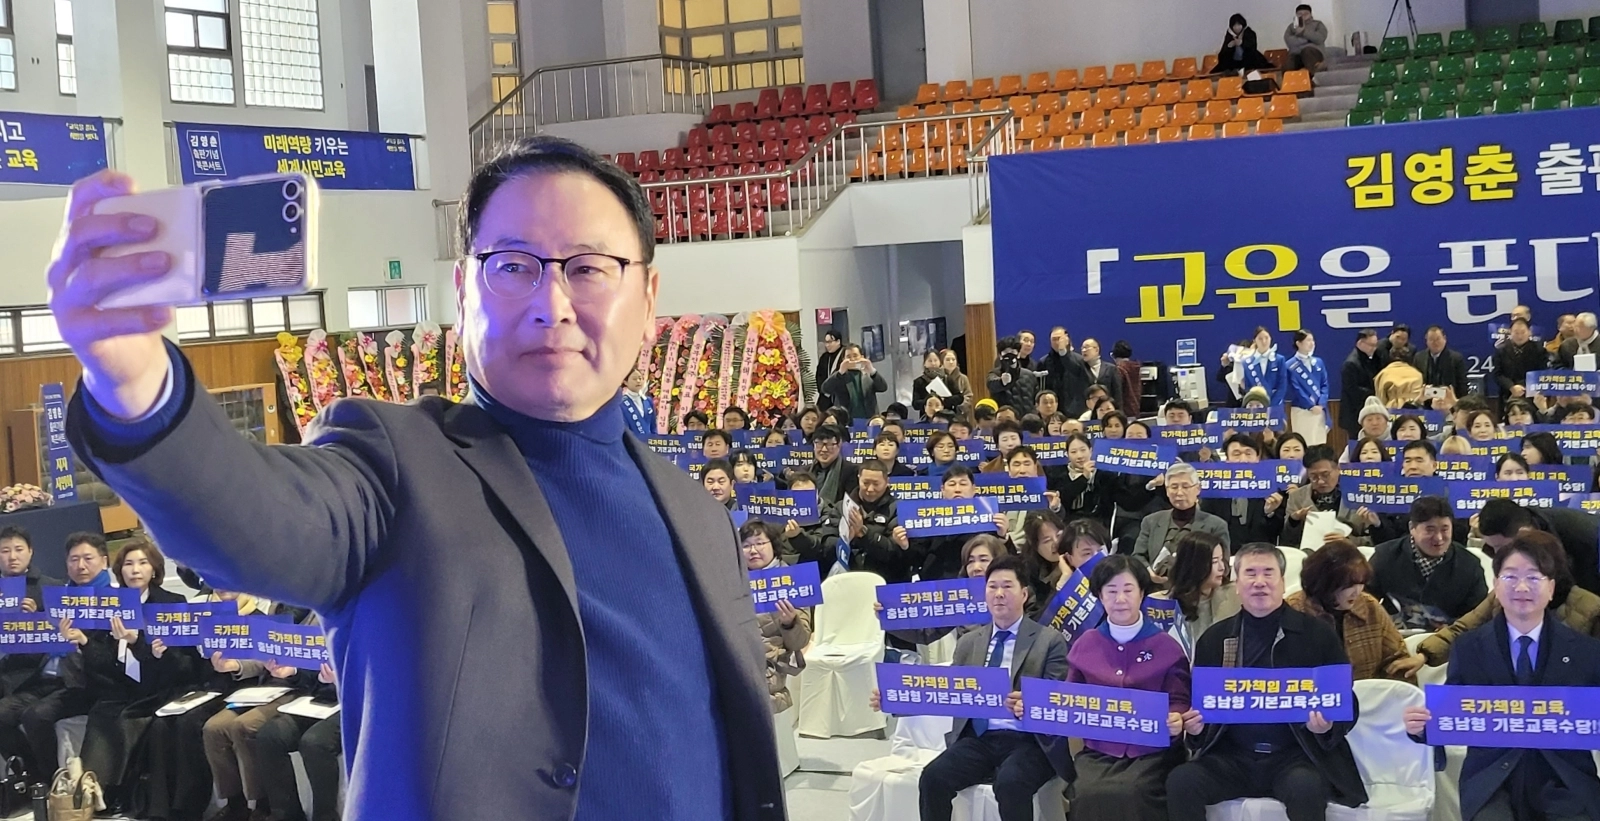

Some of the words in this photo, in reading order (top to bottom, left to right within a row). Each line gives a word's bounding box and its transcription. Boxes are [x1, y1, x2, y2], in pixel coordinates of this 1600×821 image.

[263, 134, 312, 154] 미래역량
[314, 136, 349, 155] 키우는
[5, 149, 38, 171] 교육
[277, 158, 346, 178] 세계시민교육
[1346, 145, 1518, 208] 김영춘
[1535, 142, 1600, 196] 출
[1087, 244, 1401, 331] 「교육을
[1552, 431, 1580, 439] 가책임
[1563, 440, 1600, 448] 기본교육
[1036, 451, 1068, 459] 기본교육
[1121, 459, 1169, 470] 기본교육수당!
[1213, 480, 1271, 489] 기본교육수당!
[998, 494, 1041, 503] 본교육수당!
[1376, 494, 1421, 504] 기본교육
[918, 507, 953, 517] 국가책임
[957, 505, 977, 515] 교육,
[905, 519, 932, 529] 충남형
[935, 514, 992, 526] 기본교육수당!
[749, 578, 767, 590] 책임
[771, 575, 795, 587] 교육,
[61, 596, 98, 606] 국가책임
[101, 597, 121, 607] 교육,
[900, 590, 943, 604] 국가책임
[948, 588, 973, 601] 교육,
[79, 608, 135, 620] 기본교육수당!
[156, 612, 191, 623] 국가책임
[887, 606, 919, 620] 충남형
[1050, 596, 1079, 630] 가책임
[3, 621, 34, 631] 국가책임
[173, 625, 199, 636] 기본교
[214, 625, 249, 636] 국가책임
[268, 631, 302, 644] 국가책임
[284, 646, 329, 660] 기본교육수
[902, 675, 949, 689] 국가책임
[953, 678, 981, 690] 교육,
[1224, 680, 1280, 693] 국가책임
[1286, 680, 1318, 693] 교육,
[886, 689, 921, 703] 충남형
[925, 692, 1003, 707] 기본교육수당!
[1049, 692, 1100, 710] 국가책임
[1106, 699, 1137, 714] 교육,
[1203, 695, 1245, 709] 충남형
[1250, 693, 1341, 709] 기본교육수당!
[1461, 699, 1525, 714] 국가책임
[1532, 700, 1570, 715] 교육,
[1030, 706, 1068, 722] 충남형
[1073, 711, 1159, 733] 기본교육수당!
[1438, 717, 1486, 731] 충남형
[1492, 718, 1597, 734] 기본교육수당!
